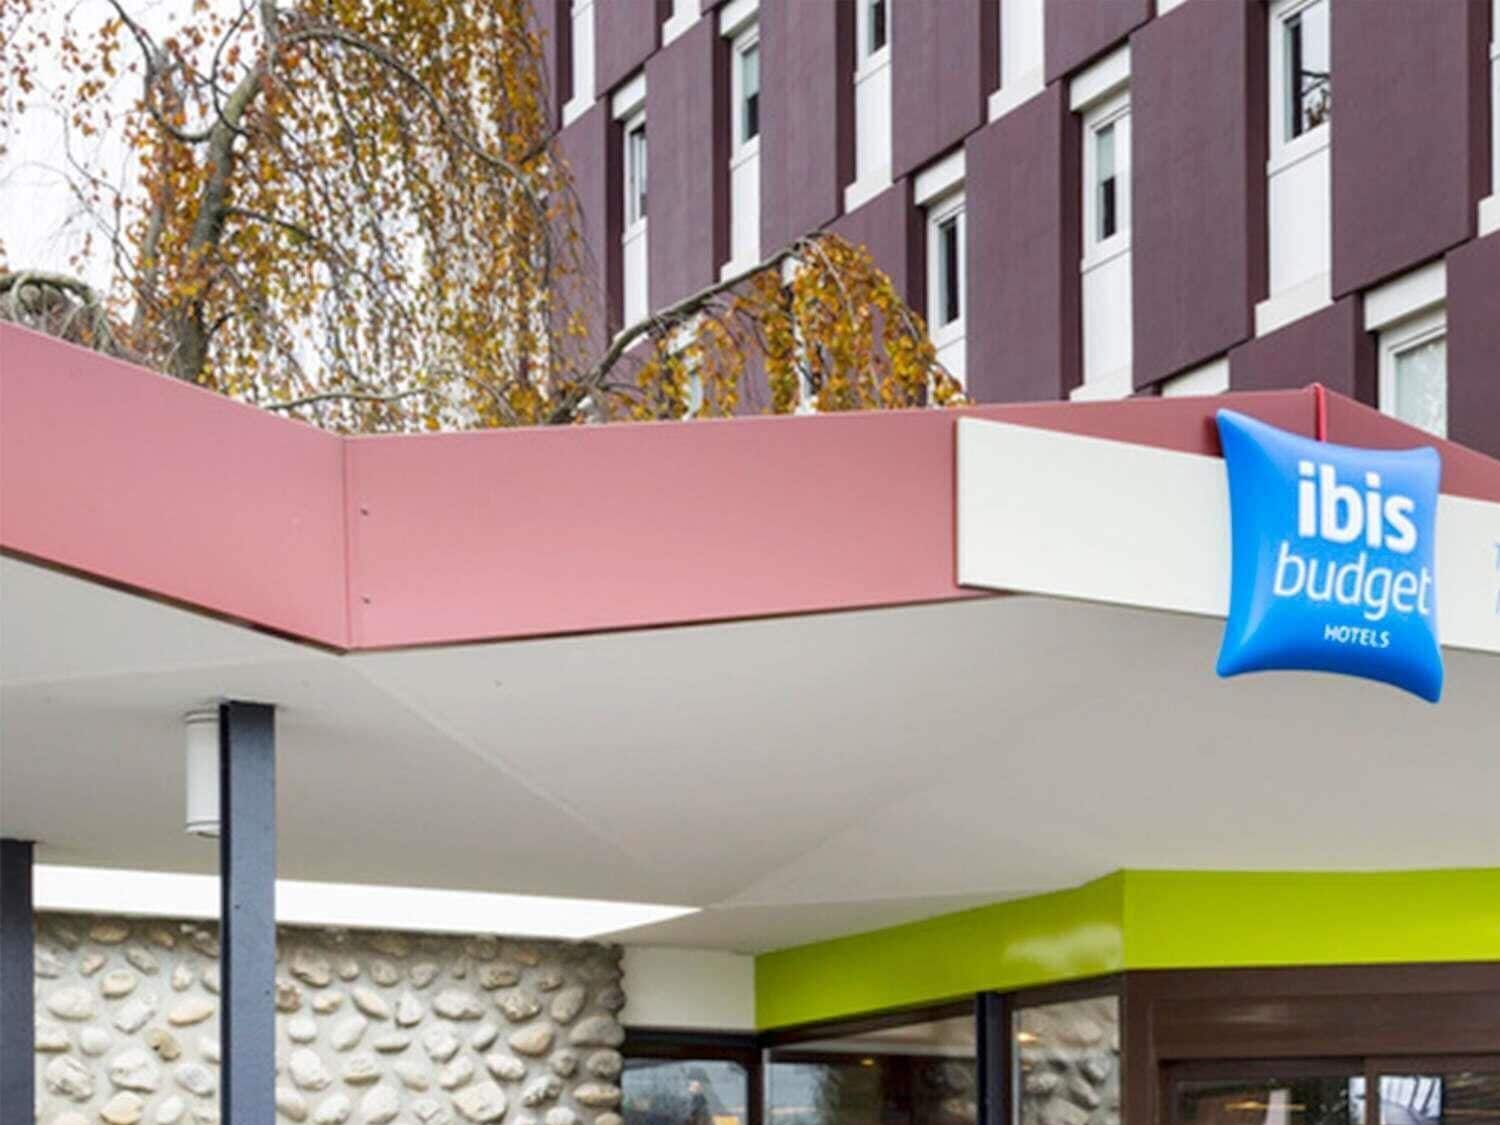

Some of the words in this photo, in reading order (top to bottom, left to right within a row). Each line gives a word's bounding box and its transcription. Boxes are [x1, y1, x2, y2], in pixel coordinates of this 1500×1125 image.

[1298, 460, 1418, 554] ibis
[1272, 539, 1432, 622] budget
[1323, 624, 1391, 649] HOTELS
